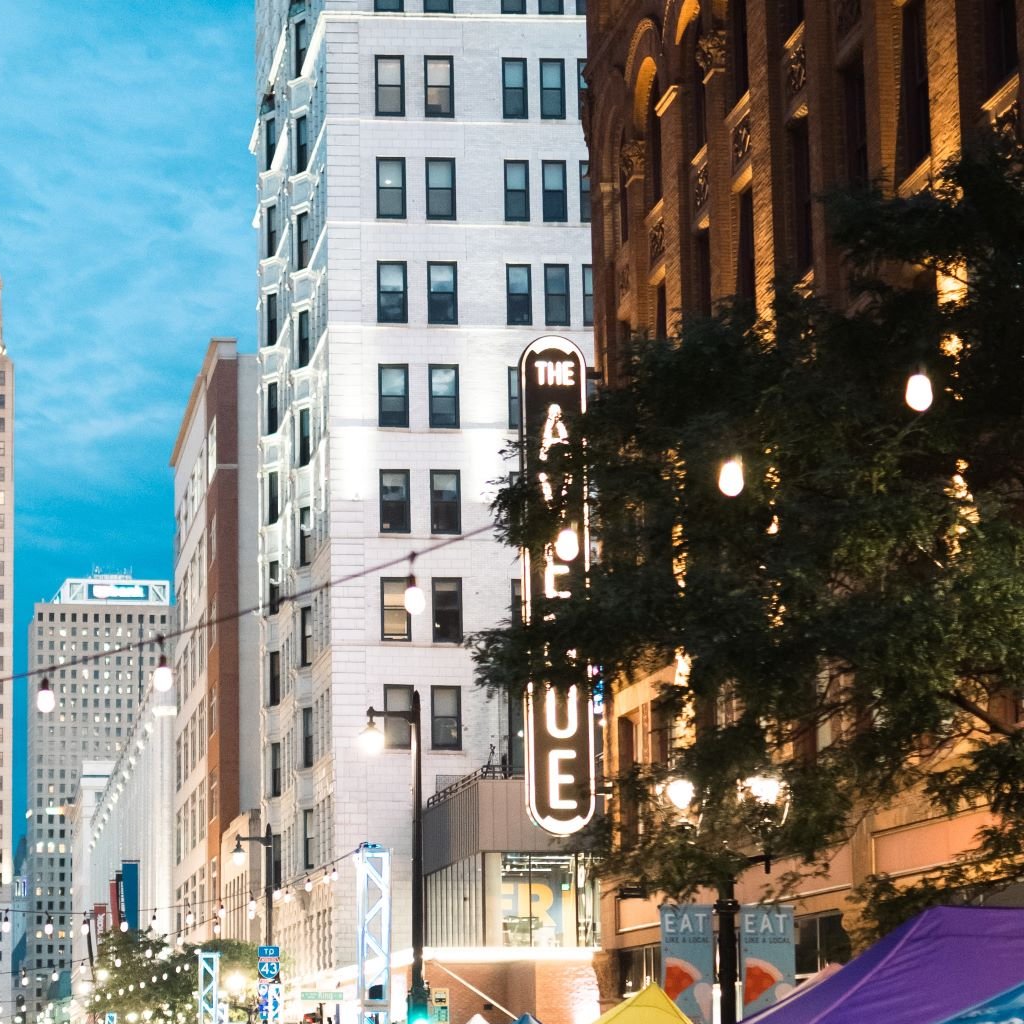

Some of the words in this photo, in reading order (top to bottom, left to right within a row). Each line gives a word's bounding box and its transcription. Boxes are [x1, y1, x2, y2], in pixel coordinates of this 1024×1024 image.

[535, 361, 576, 386] THE
[538, 404, 578, 810] AVEUE
[664, 913, 707, 933] EAT
[744, 913, 788, 933] EAT
[260, 962, 277, 975] 43
